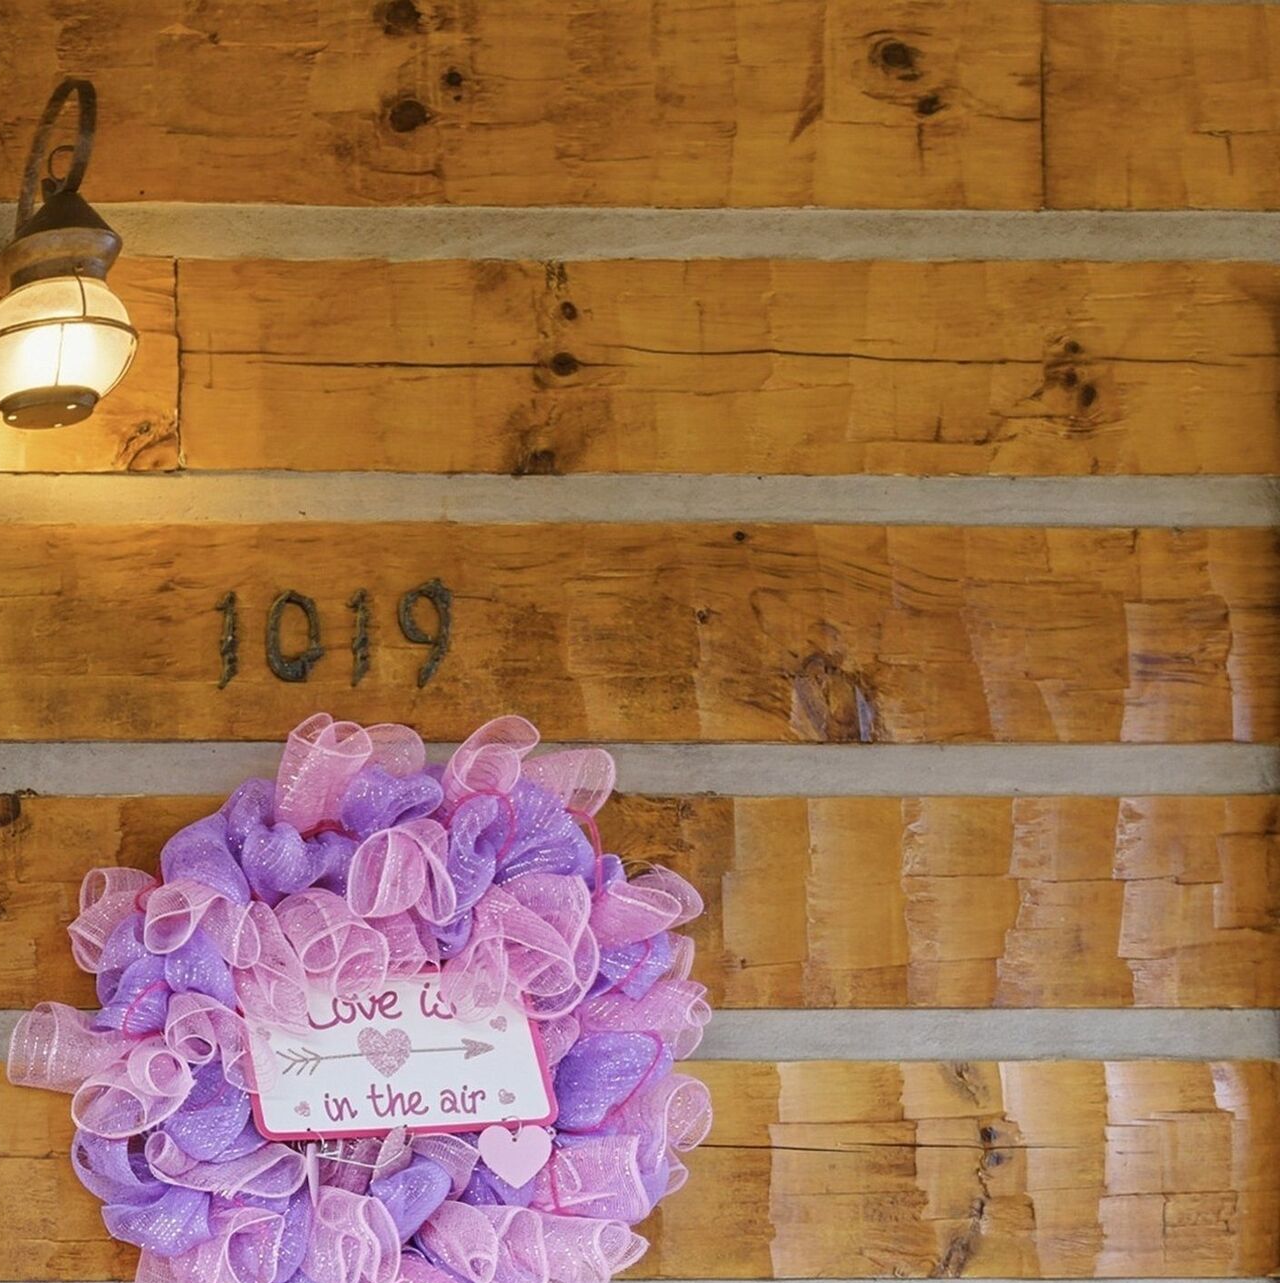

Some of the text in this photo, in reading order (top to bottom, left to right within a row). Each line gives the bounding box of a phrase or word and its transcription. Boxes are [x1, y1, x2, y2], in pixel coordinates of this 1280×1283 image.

[216, 577, 452, 689] 1019
[324, 1083, 486, 1122] in the air
